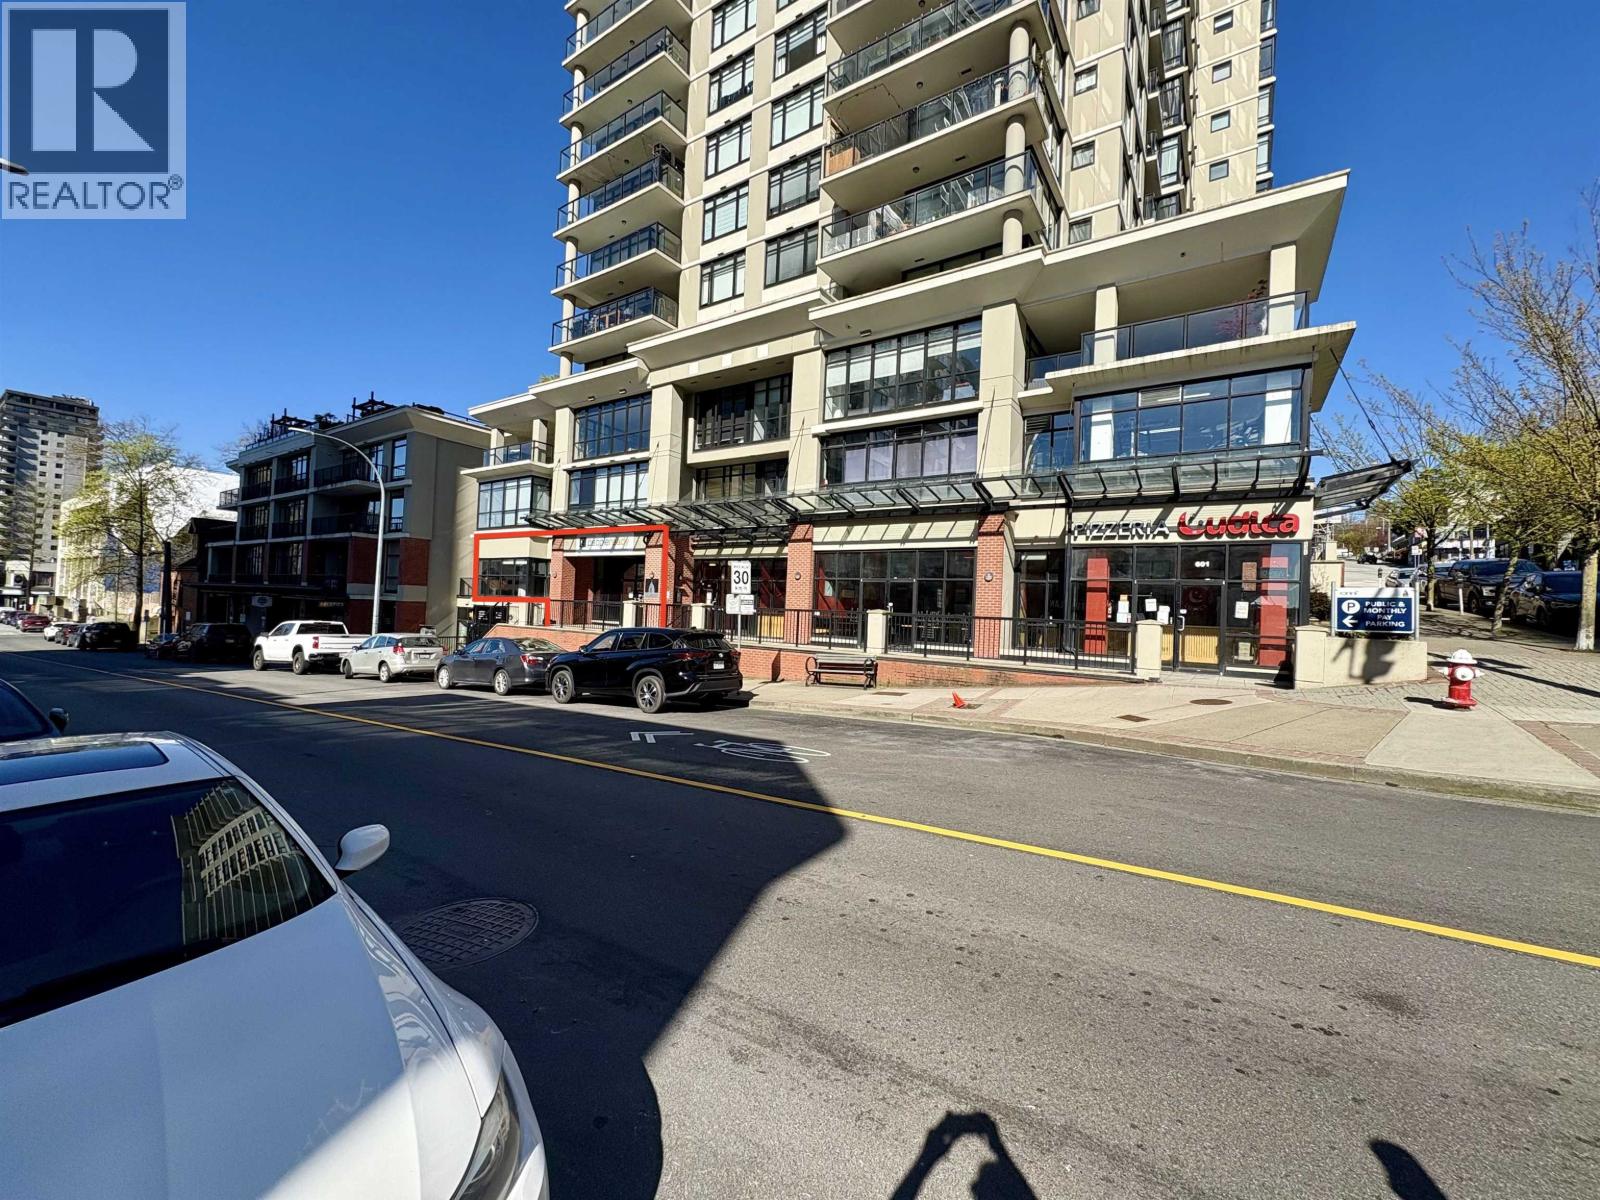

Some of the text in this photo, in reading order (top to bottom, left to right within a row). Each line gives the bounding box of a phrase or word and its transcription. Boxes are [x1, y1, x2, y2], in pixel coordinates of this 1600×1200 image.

[1074, 520, 1170, 536] PIZZERIA
[733, 570, 749, 585] 30
[1347, 602, 1356, 612] P
[1364, 620, 1406, 628] PARKING
